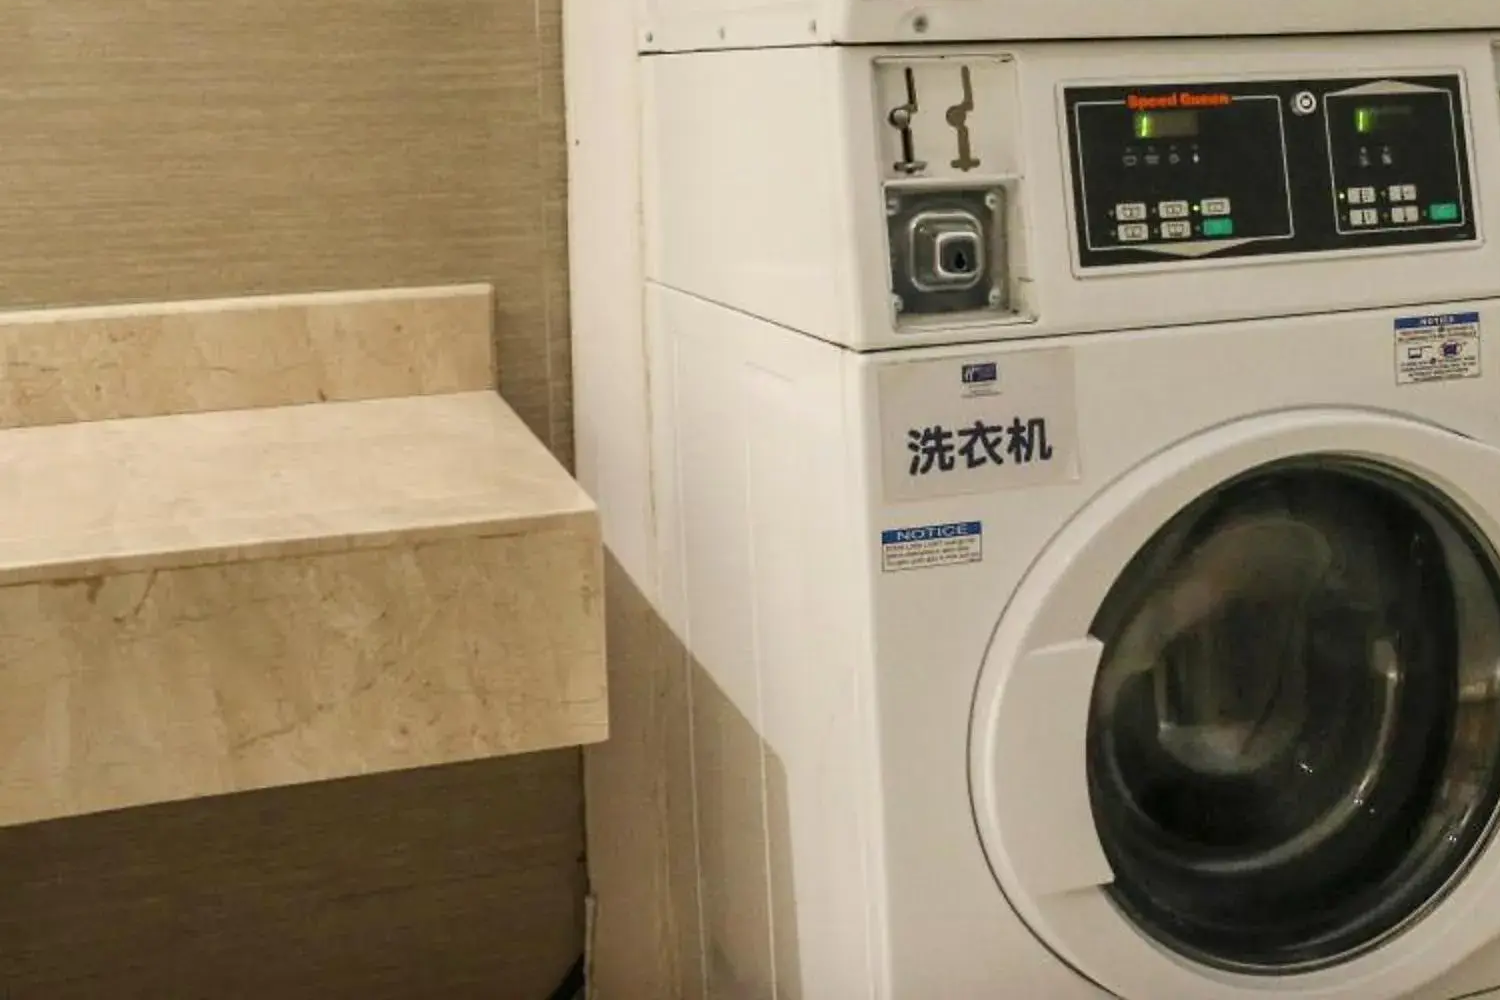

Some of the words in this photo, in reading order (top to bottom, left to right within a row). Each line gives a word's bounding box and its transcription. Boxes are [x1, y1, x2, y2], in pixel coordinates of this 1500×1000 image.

[907, 415, 1053, 476] 洗衣机
[896, 523, 969, 542] NOTICE
